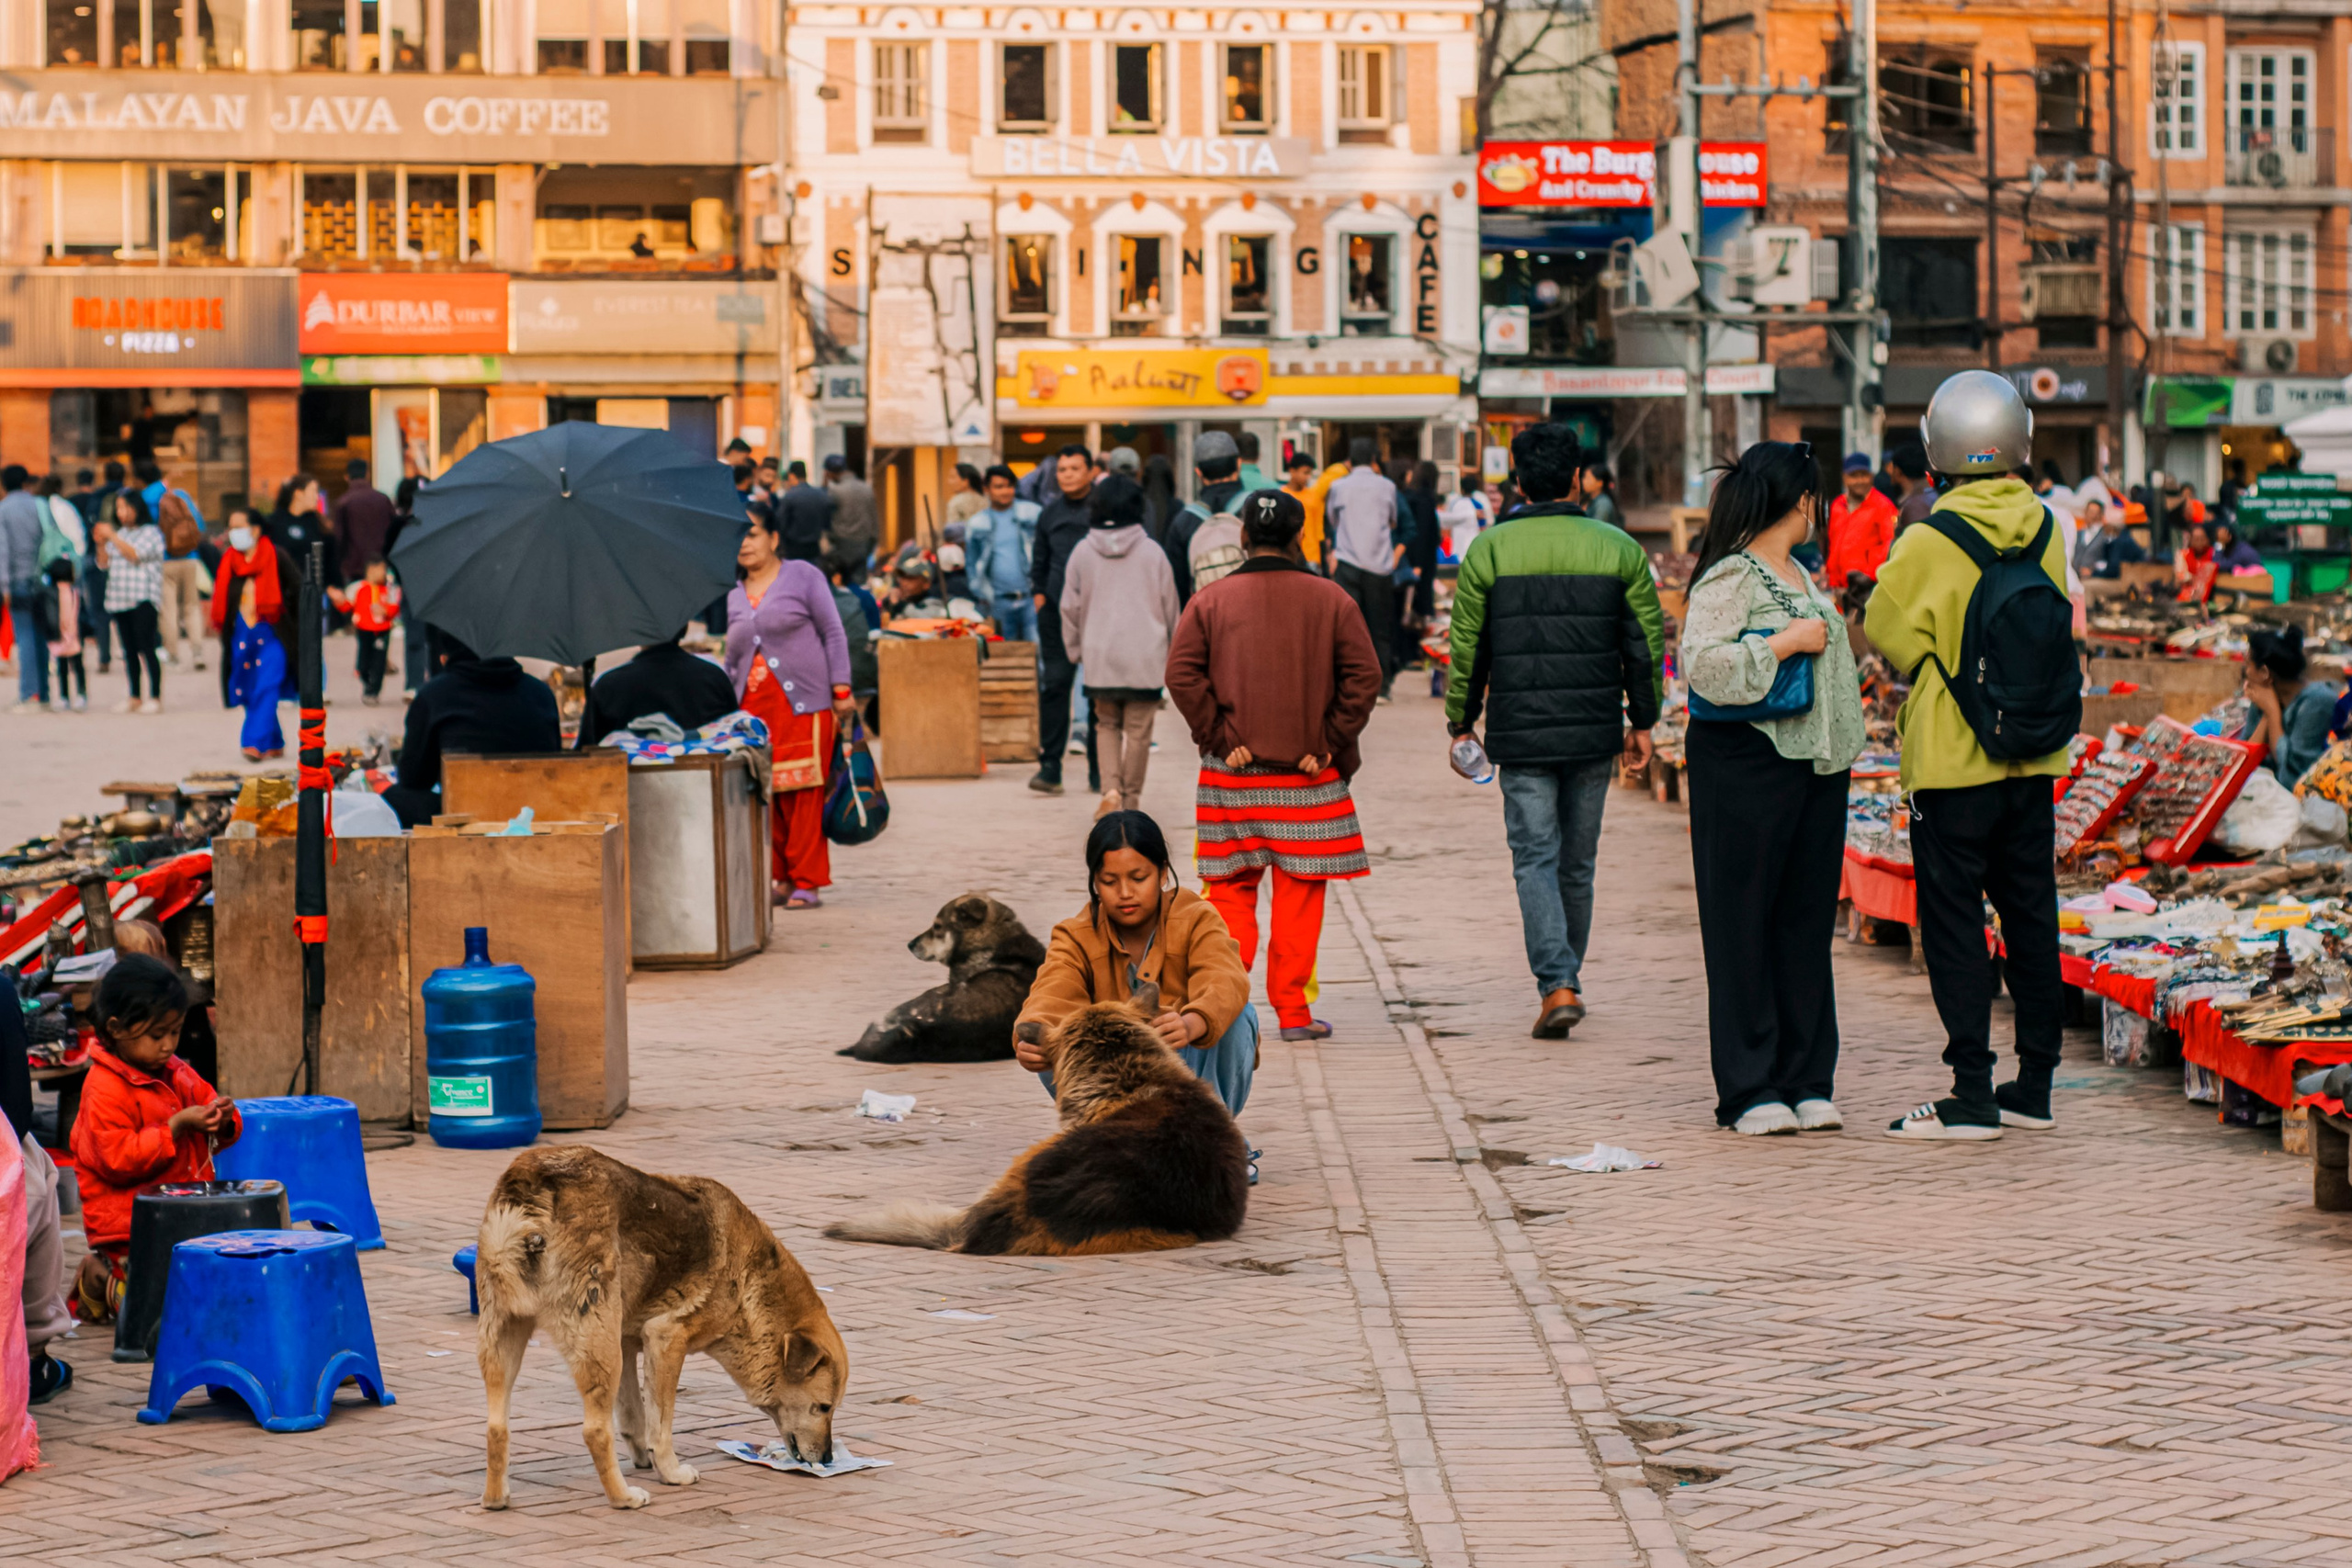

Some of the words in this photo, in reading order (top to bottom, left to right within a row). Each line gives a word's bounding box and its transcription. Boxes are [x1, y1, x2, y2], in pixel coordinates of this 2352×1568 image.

[270, 95, 401, 133] JAVA
[423, 96, 611, 136] COFFEE
[1002, 139, 1144, 175] BELLA
[1159, 139, 1282, 175] VISTA
[1540, 145, 1590, 175] The
[1591, 146, 1655, 182] Burg
[1698, 152, 1759, 175] ouse
[1538, 180, 1572, 199] And
[1574, 180, 1645, 204] Crunchy
[1702, 181, 1760, 200] hicken
[72, 296, 225, 331] ROADHOUSE
[337, 299, 454, 324] DURBAR
[454, 308, 499, 323] VIEW
[120, 332, 180, 354] PIZZA
[1656, 369, 1688, 388] Foo
[1966, 453, 1996, 464] TVS
